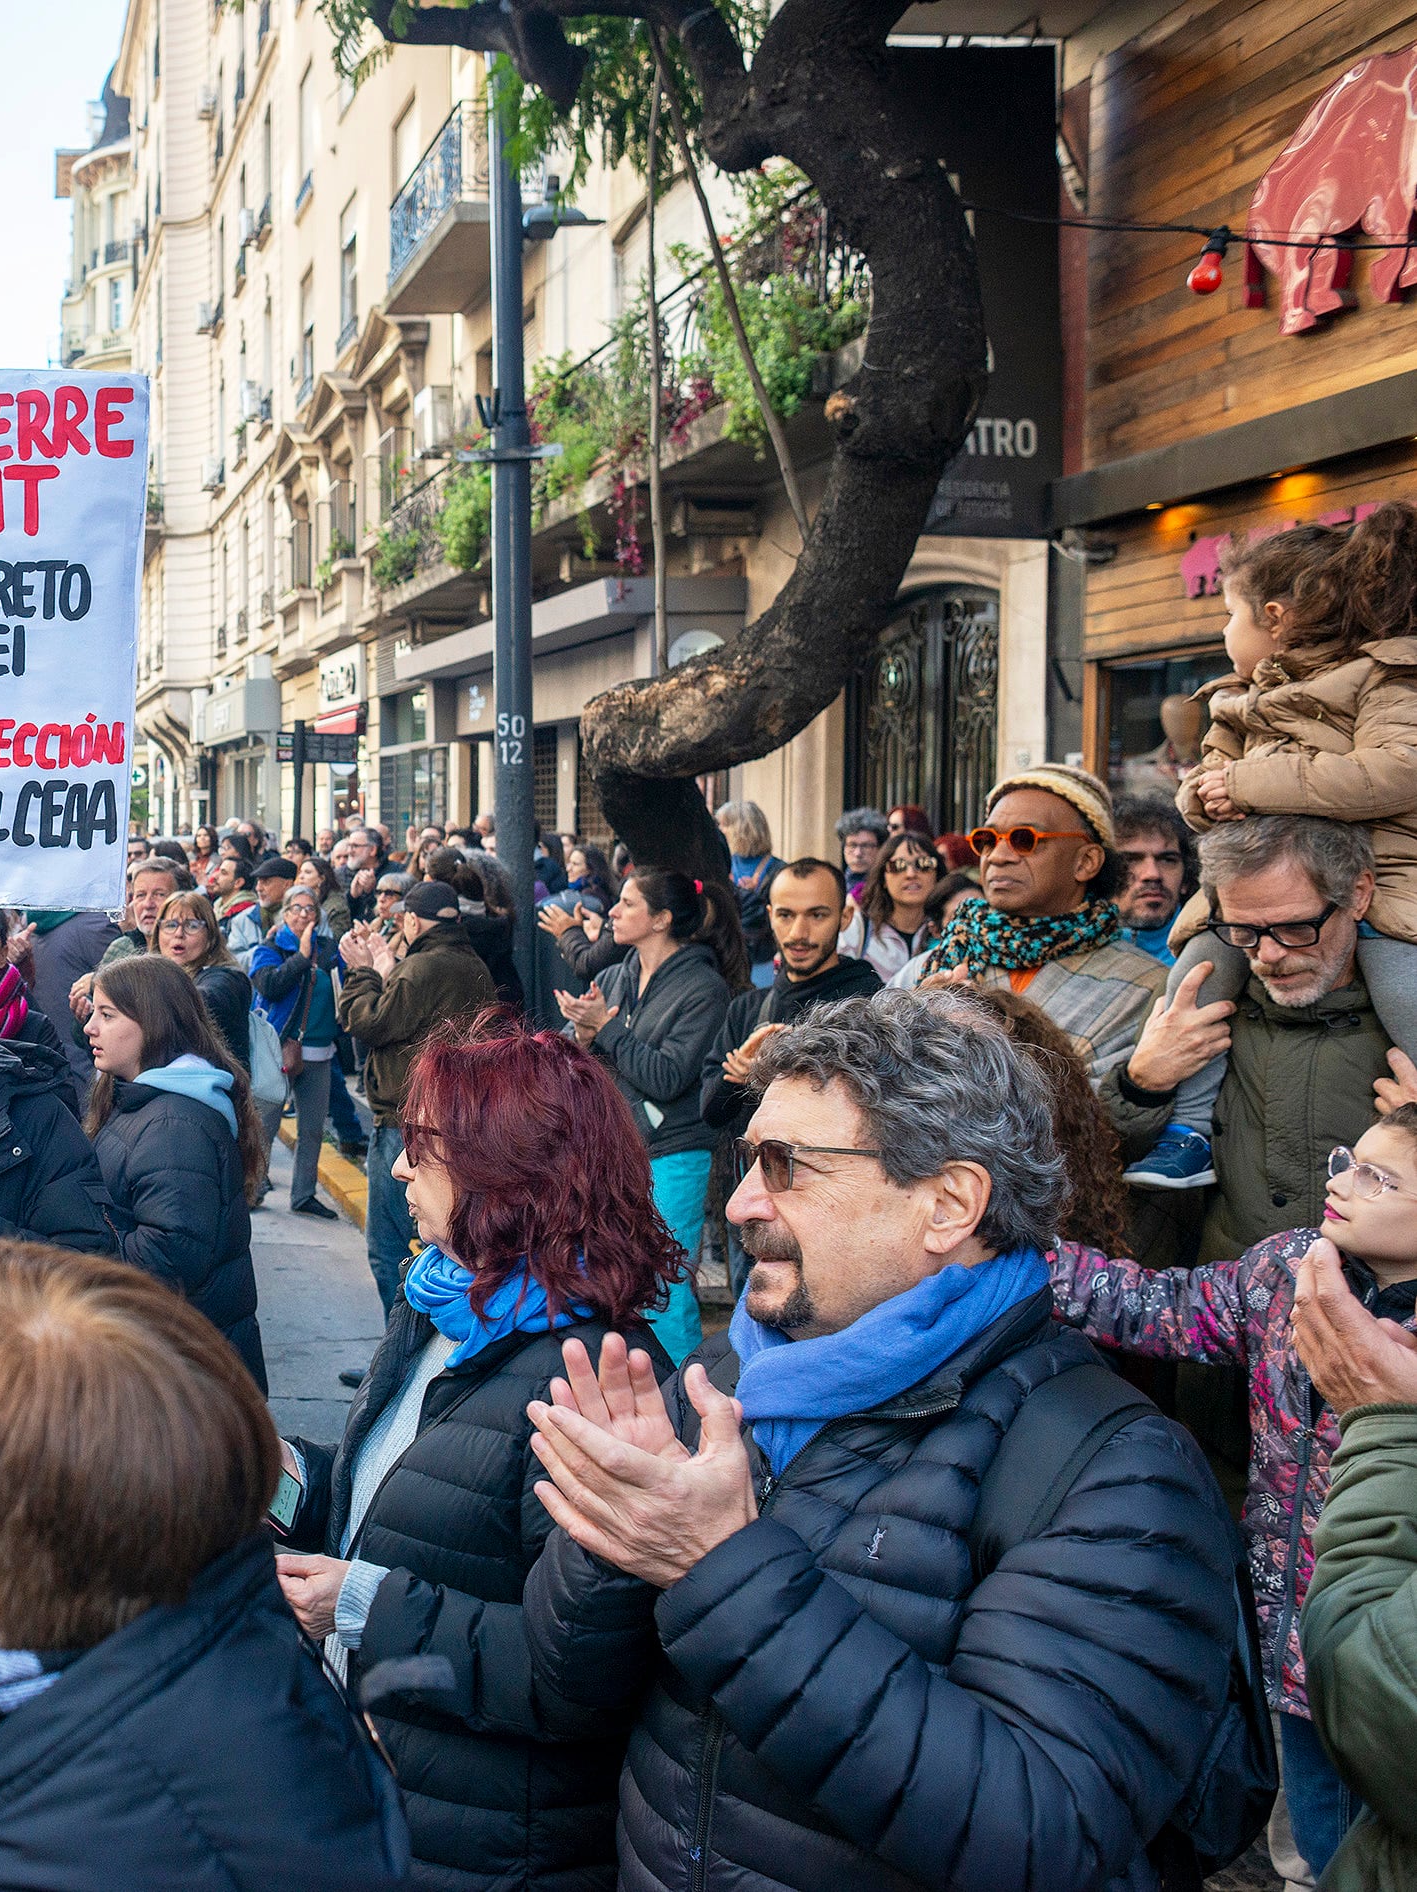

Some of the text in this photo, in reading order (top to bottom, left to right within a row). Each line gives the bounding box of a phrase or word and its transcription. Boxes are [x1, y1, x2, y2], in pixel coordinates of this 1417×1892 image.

[497, 712, 526, 738] 50
[499, 740, 524, 766] 12
[11, 779, 119, 851] CEAA
